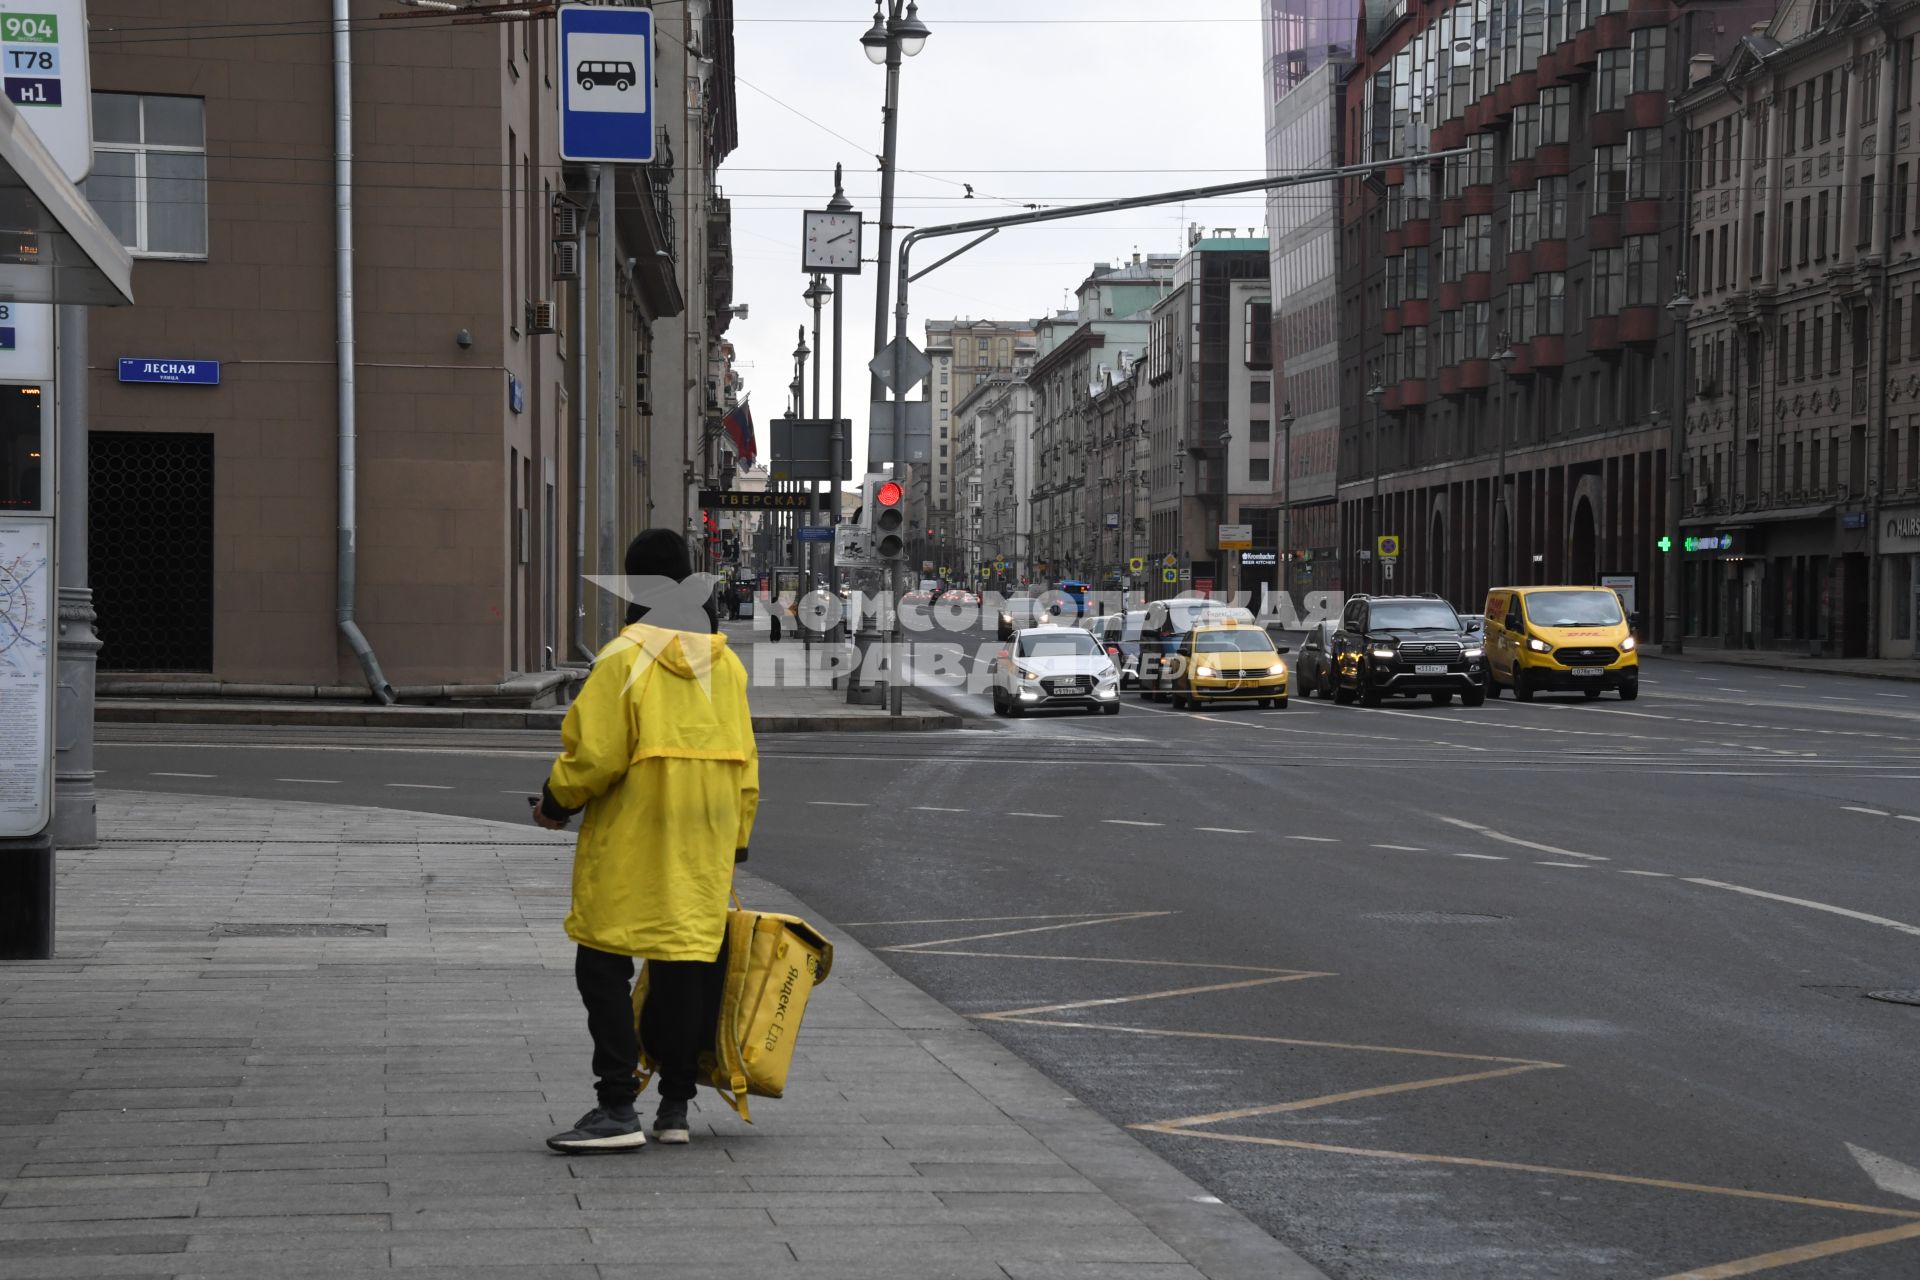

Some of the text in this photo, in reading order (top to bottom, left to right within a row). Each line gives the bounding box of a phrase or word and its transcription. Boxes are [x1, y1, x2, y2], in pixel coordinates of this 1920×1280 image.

[6, 18, 53, 38] 904
[143, 363, 196, 375] ЛЕСНАЯ
[720, 495, 807, 506] ТВЕРСКАЯ
[776, 965, 798, 1021] Яндекс
